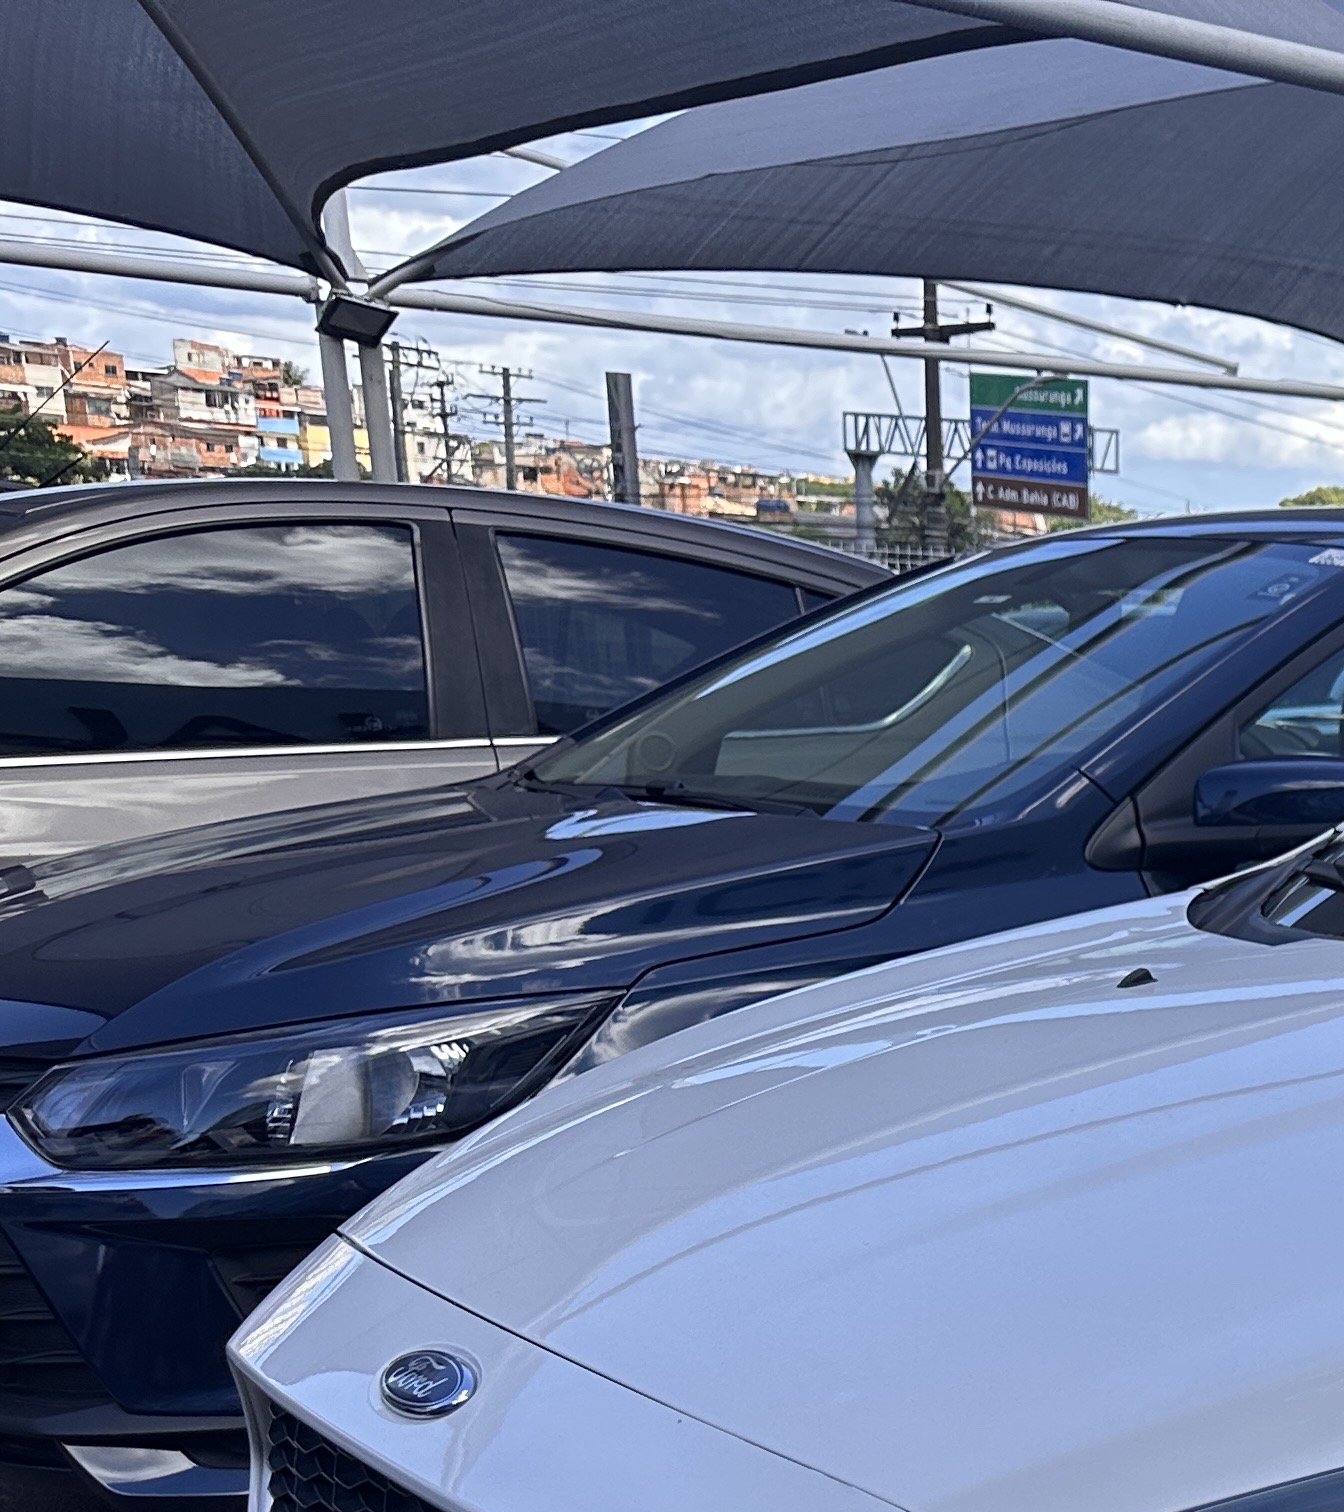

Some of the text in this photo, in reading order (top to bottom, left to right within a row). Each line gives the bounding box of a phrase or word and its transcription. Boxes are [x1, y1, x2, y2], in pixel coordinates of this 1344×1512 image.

[1021, 487, 1049, 506] Bahia
[1051, 490, 1079, 511] (CAB)
[386, 1356, 449, 1398] Ford
